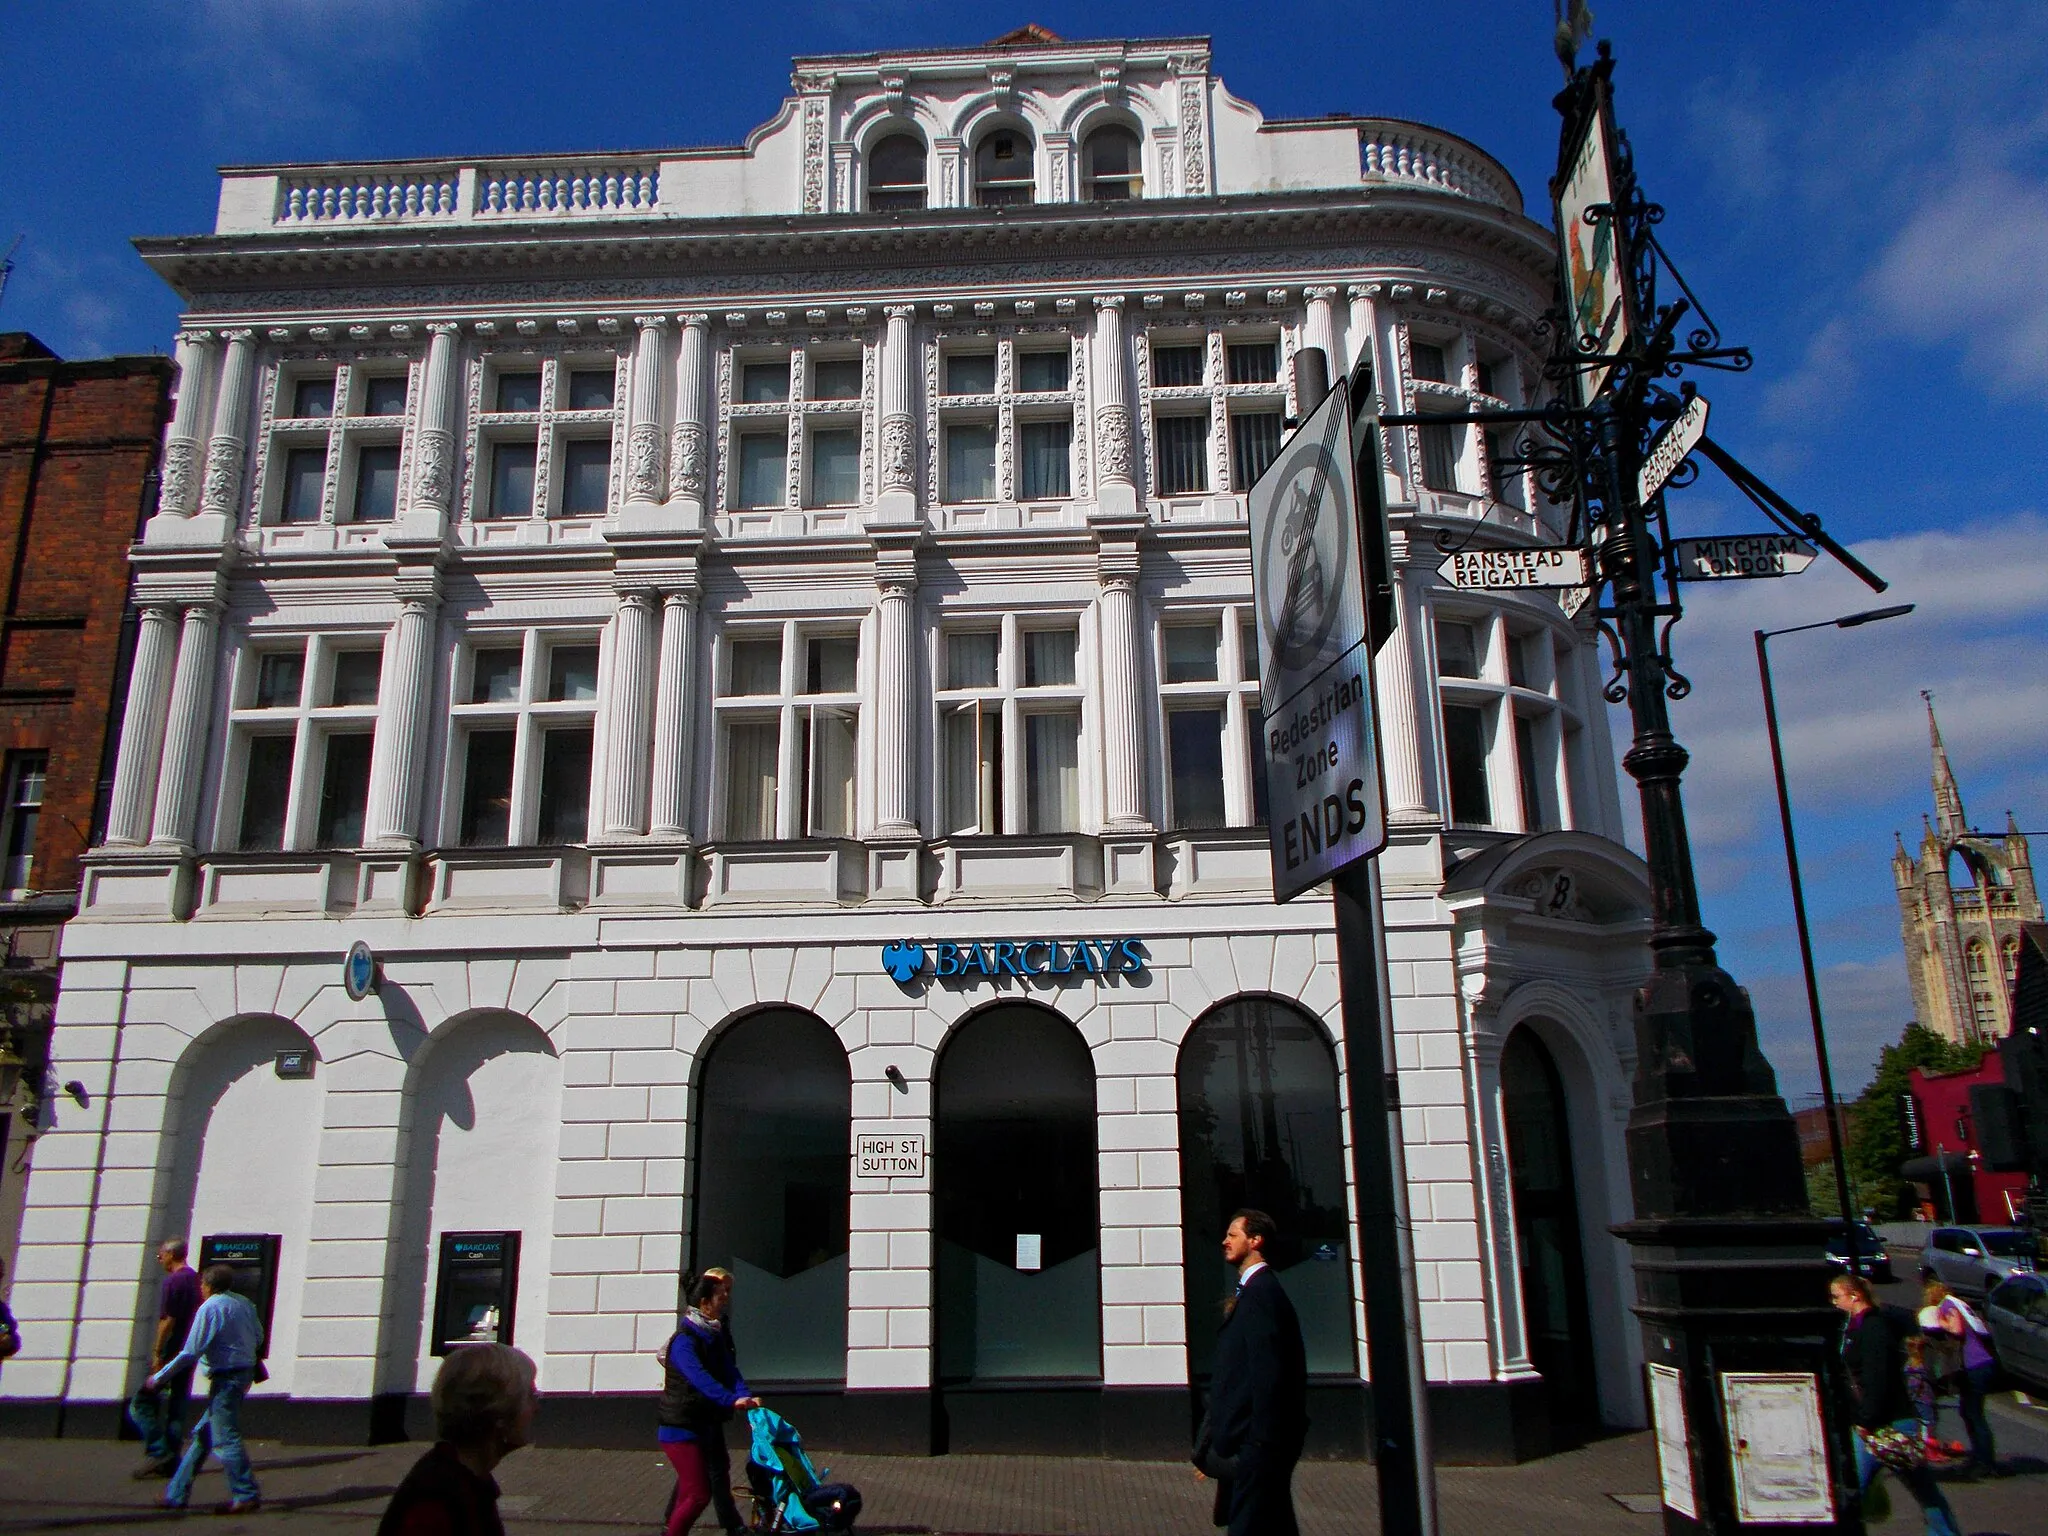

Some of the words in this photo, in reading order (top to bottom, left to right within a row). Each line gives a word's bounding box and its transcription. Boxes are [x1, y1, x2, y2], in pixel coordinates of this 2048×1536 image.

[1643, 398, 1699, 480] CARSHALTON
[1645, 433, 1685, 498] CROYDON
[1694, 538, 1798, 558] MITCHAM
[1454, 552, 1563, 570] BANSTEAD
[1697, 555, 1785, 575] LONDON
[1456, 569, 1538, 586] REIGATE
[1270, 673, 1364, 763] Pedestrian
[1295, 740, 1339, 791] Zone
[1283, 778, 1367, 871] ENDS
[935, 938, 1144, 977] BARCLAYS
[284, 1056, 301, 1067] ADT
[862, 1140, 895, 1154] HIGH
[900, 1140, 919, 1154] ST.
[862, 1157, 918, 1171] SUTTON
[223, 1243, 261, 1251] BARCLAYS
[462, 1243, 501, 1251] BARCLAYS
